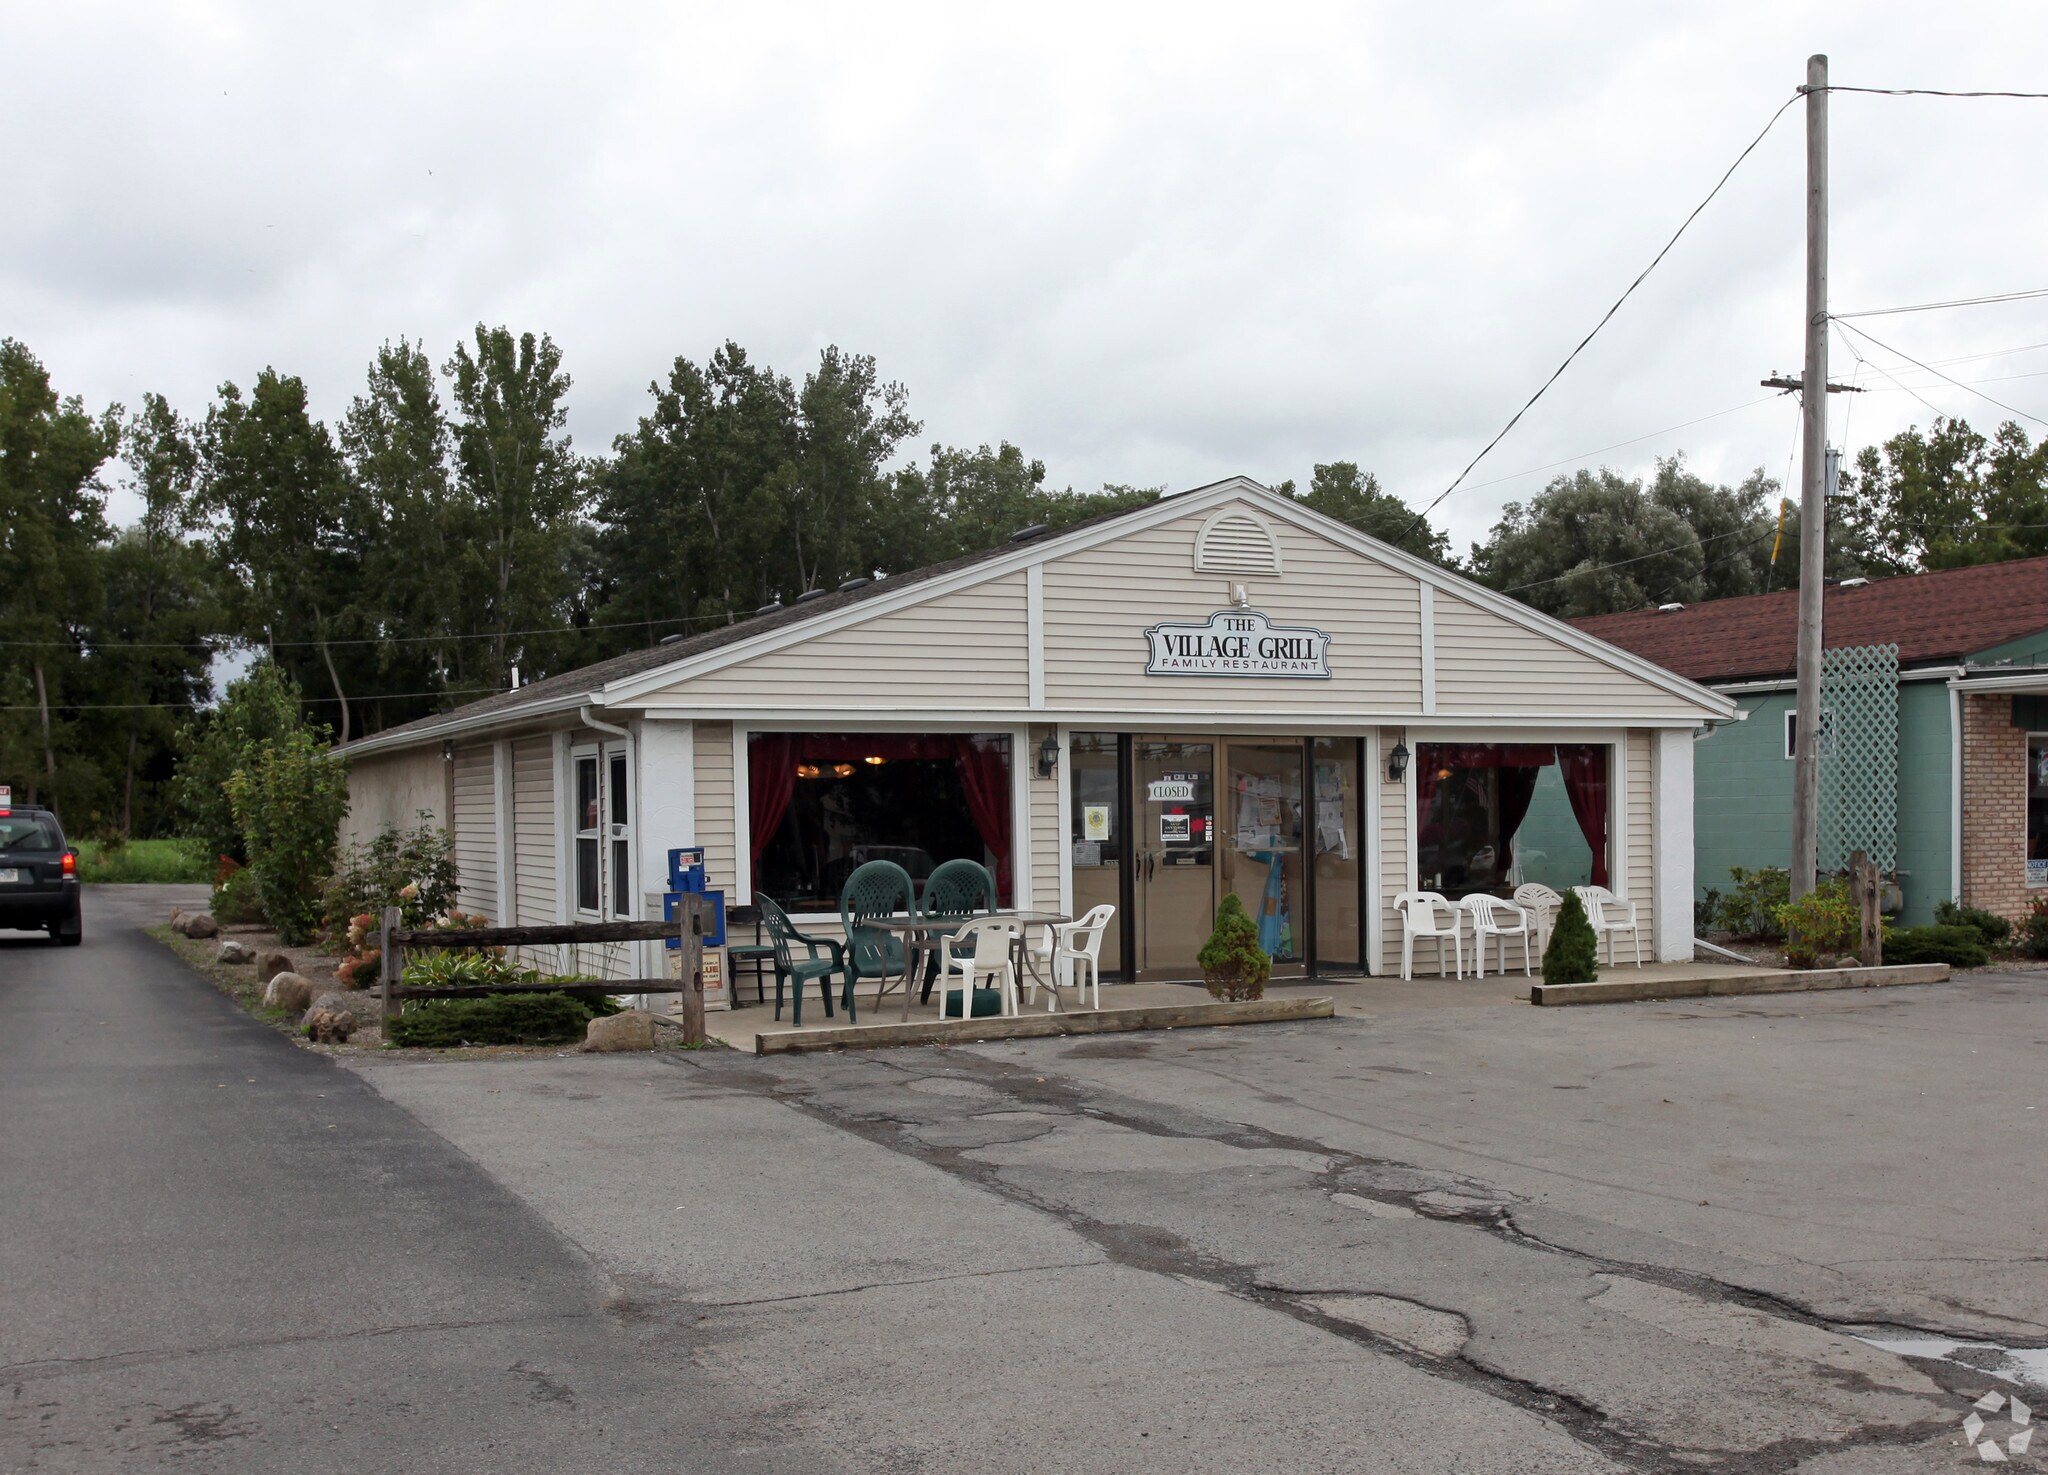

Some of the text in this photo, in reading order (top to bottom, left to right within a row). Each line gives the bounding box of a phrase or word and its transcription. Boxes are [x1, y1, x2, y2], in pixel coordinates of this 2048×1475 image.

[1224, 618, 1255, 631] THE
[1162, 634, 1318, 660] VILLAGE GRILL
[1162, 658, 1318, 670] FAMILY RESTAURANT
[1153, 786, 1189, 798] CLOSED
